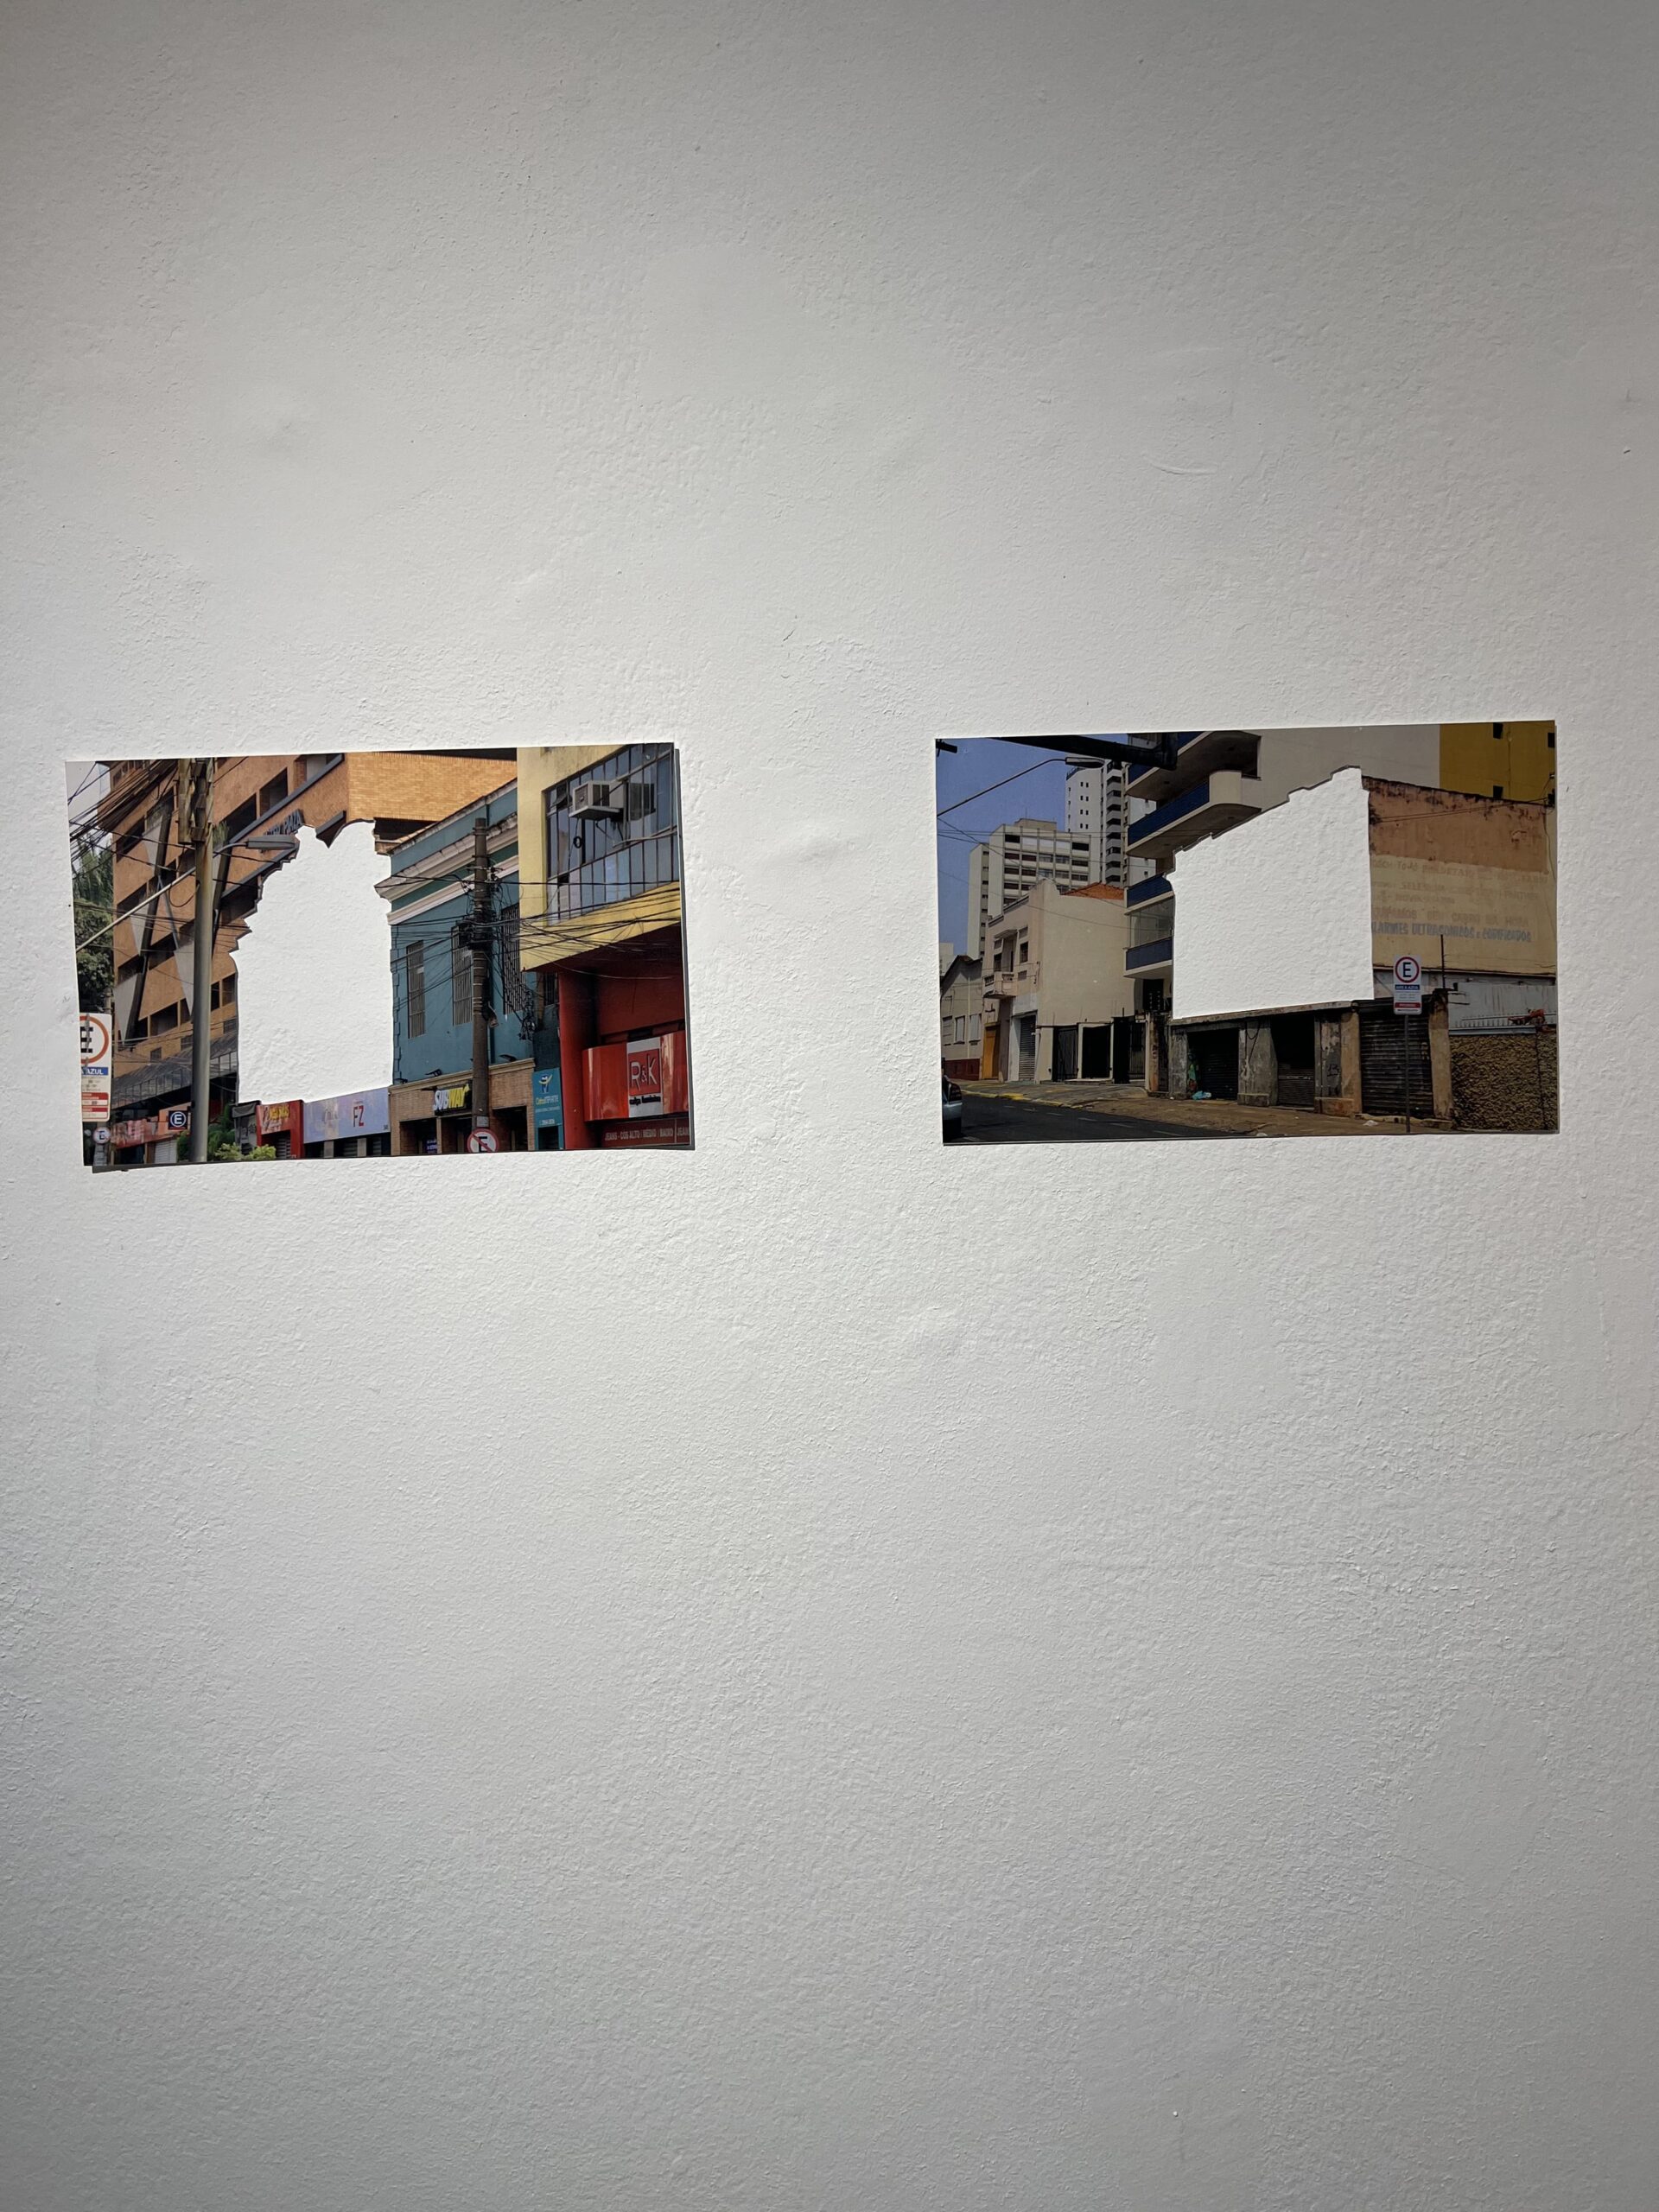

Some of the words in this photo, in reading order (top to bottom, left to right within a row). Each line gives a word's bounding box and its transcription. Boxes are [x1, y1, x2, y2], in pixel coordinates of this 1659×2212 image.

[1402, 962, 1412, 978] E
[631, 1052, 658, 1092] R&K
[433, 1083, 471, 1111] SUBWAY
[174, 1114, 183, 1125] E
[353, 1104, 365, 1128] FZ
